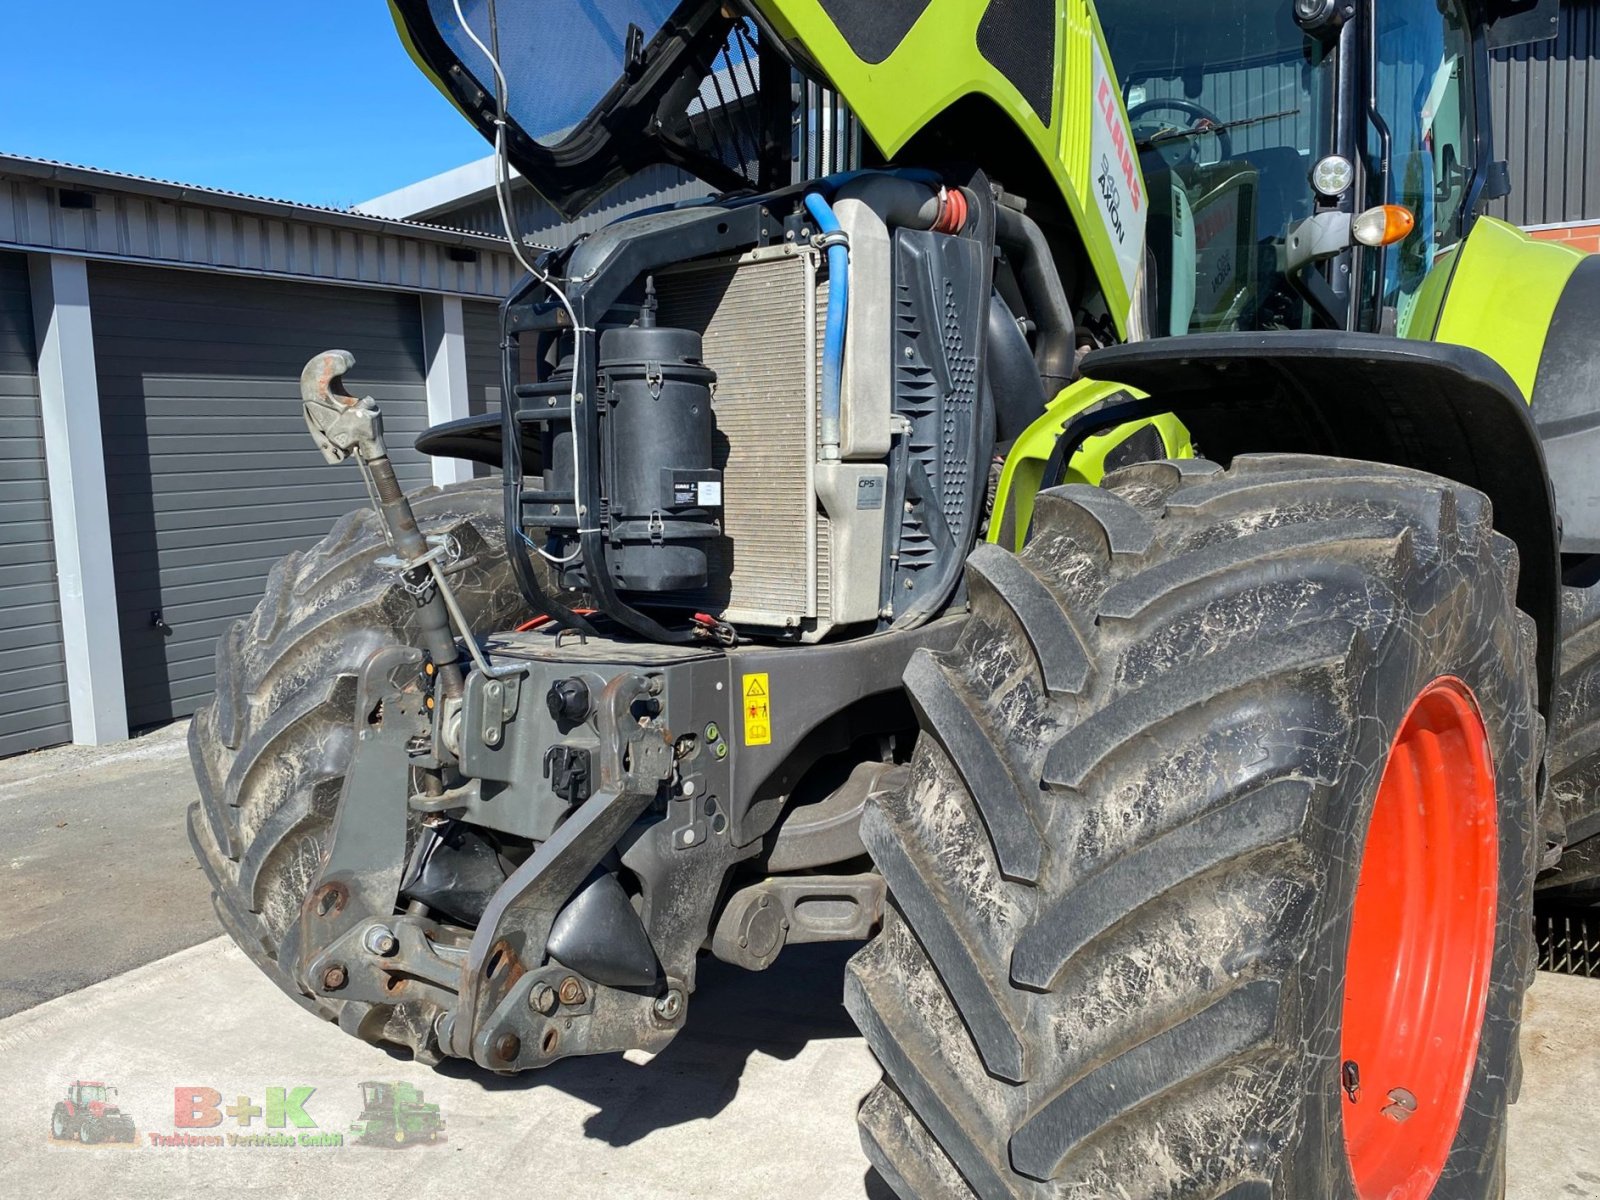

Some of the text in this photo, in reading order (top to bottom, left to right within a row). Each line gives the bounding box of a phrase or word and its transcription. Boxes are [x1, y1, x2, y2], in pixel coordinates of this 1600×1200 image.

[1097, 76, 1141, 213] CLAAS
[1098, 175, 1125, 245] AXION
[858, 479, 875, 488] CPS
